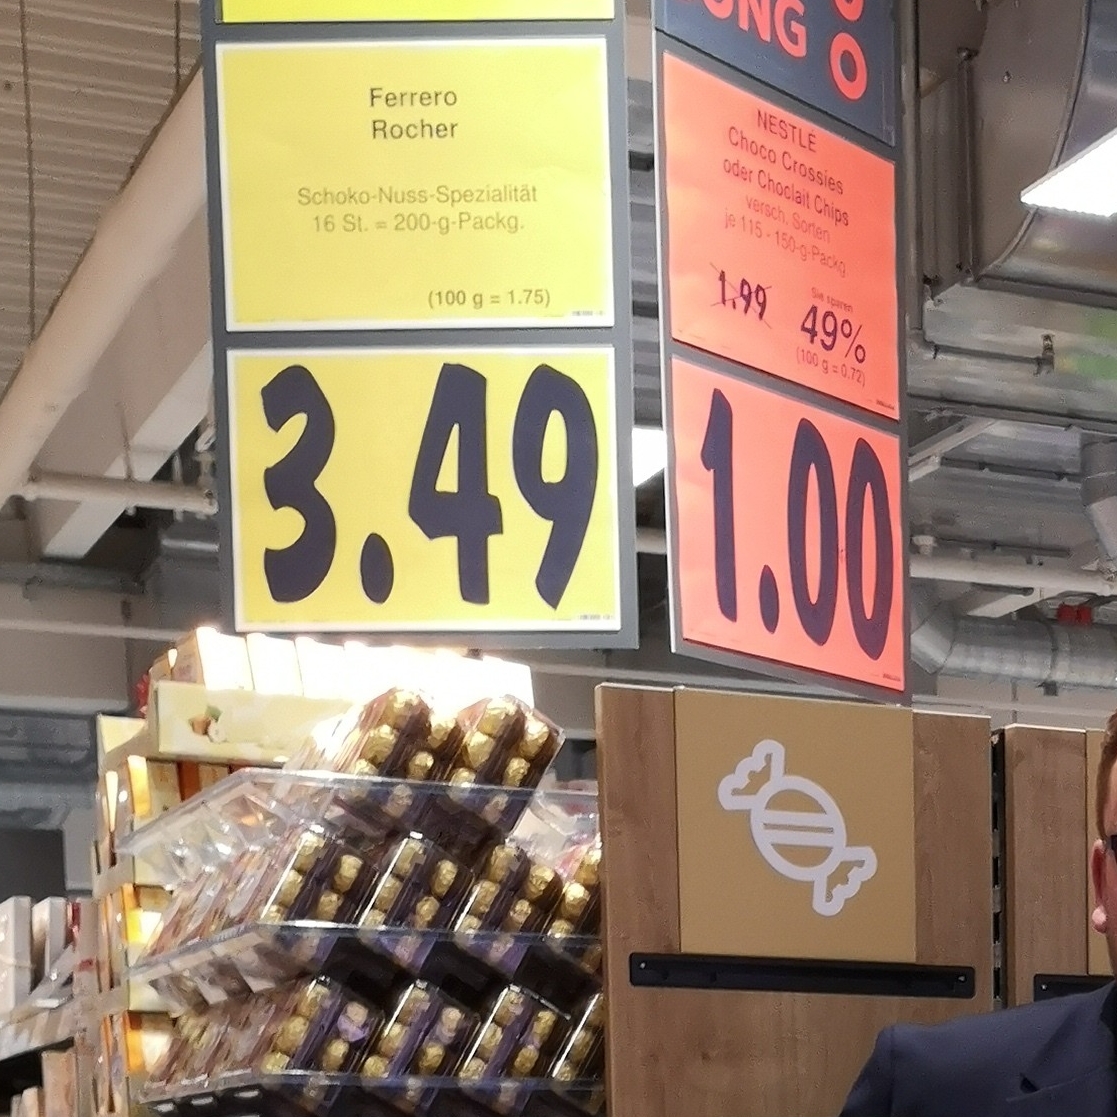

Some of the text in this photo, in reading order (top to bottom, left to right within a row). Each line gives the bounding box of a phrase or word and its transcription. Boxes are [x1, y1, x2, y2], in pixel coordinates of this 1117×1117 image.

[369, 87, 458, 107] Ferrero
[371, 118, 459, 139] Rocher
[728, 126, 845, 195] Choco Crossies
[297, 184, 538, 208] Schoko-Nuss-Spezialität
[723, 158, 849, 227] oder Choclait Chips
[312, 214, 336, 233] 16
[342, 213, 369, 232] St.
[394, 211, 525, 234] 200-g-Packg.
[724, 206, 737, 229] je
[741, 215, 763, 239] 115
[793, 211, 831, 244] Sorten
[428, 290, 466, 309] (100
[472, 294, 484, 309] g
[507, 289, 551, 308] 1.75)
[717, 269, 768, 321] 1.99
[801, 304, 867, 364] 49%
[260, 362, 600, 610] 3.49
[701, 387, 894, 660] 1.00
